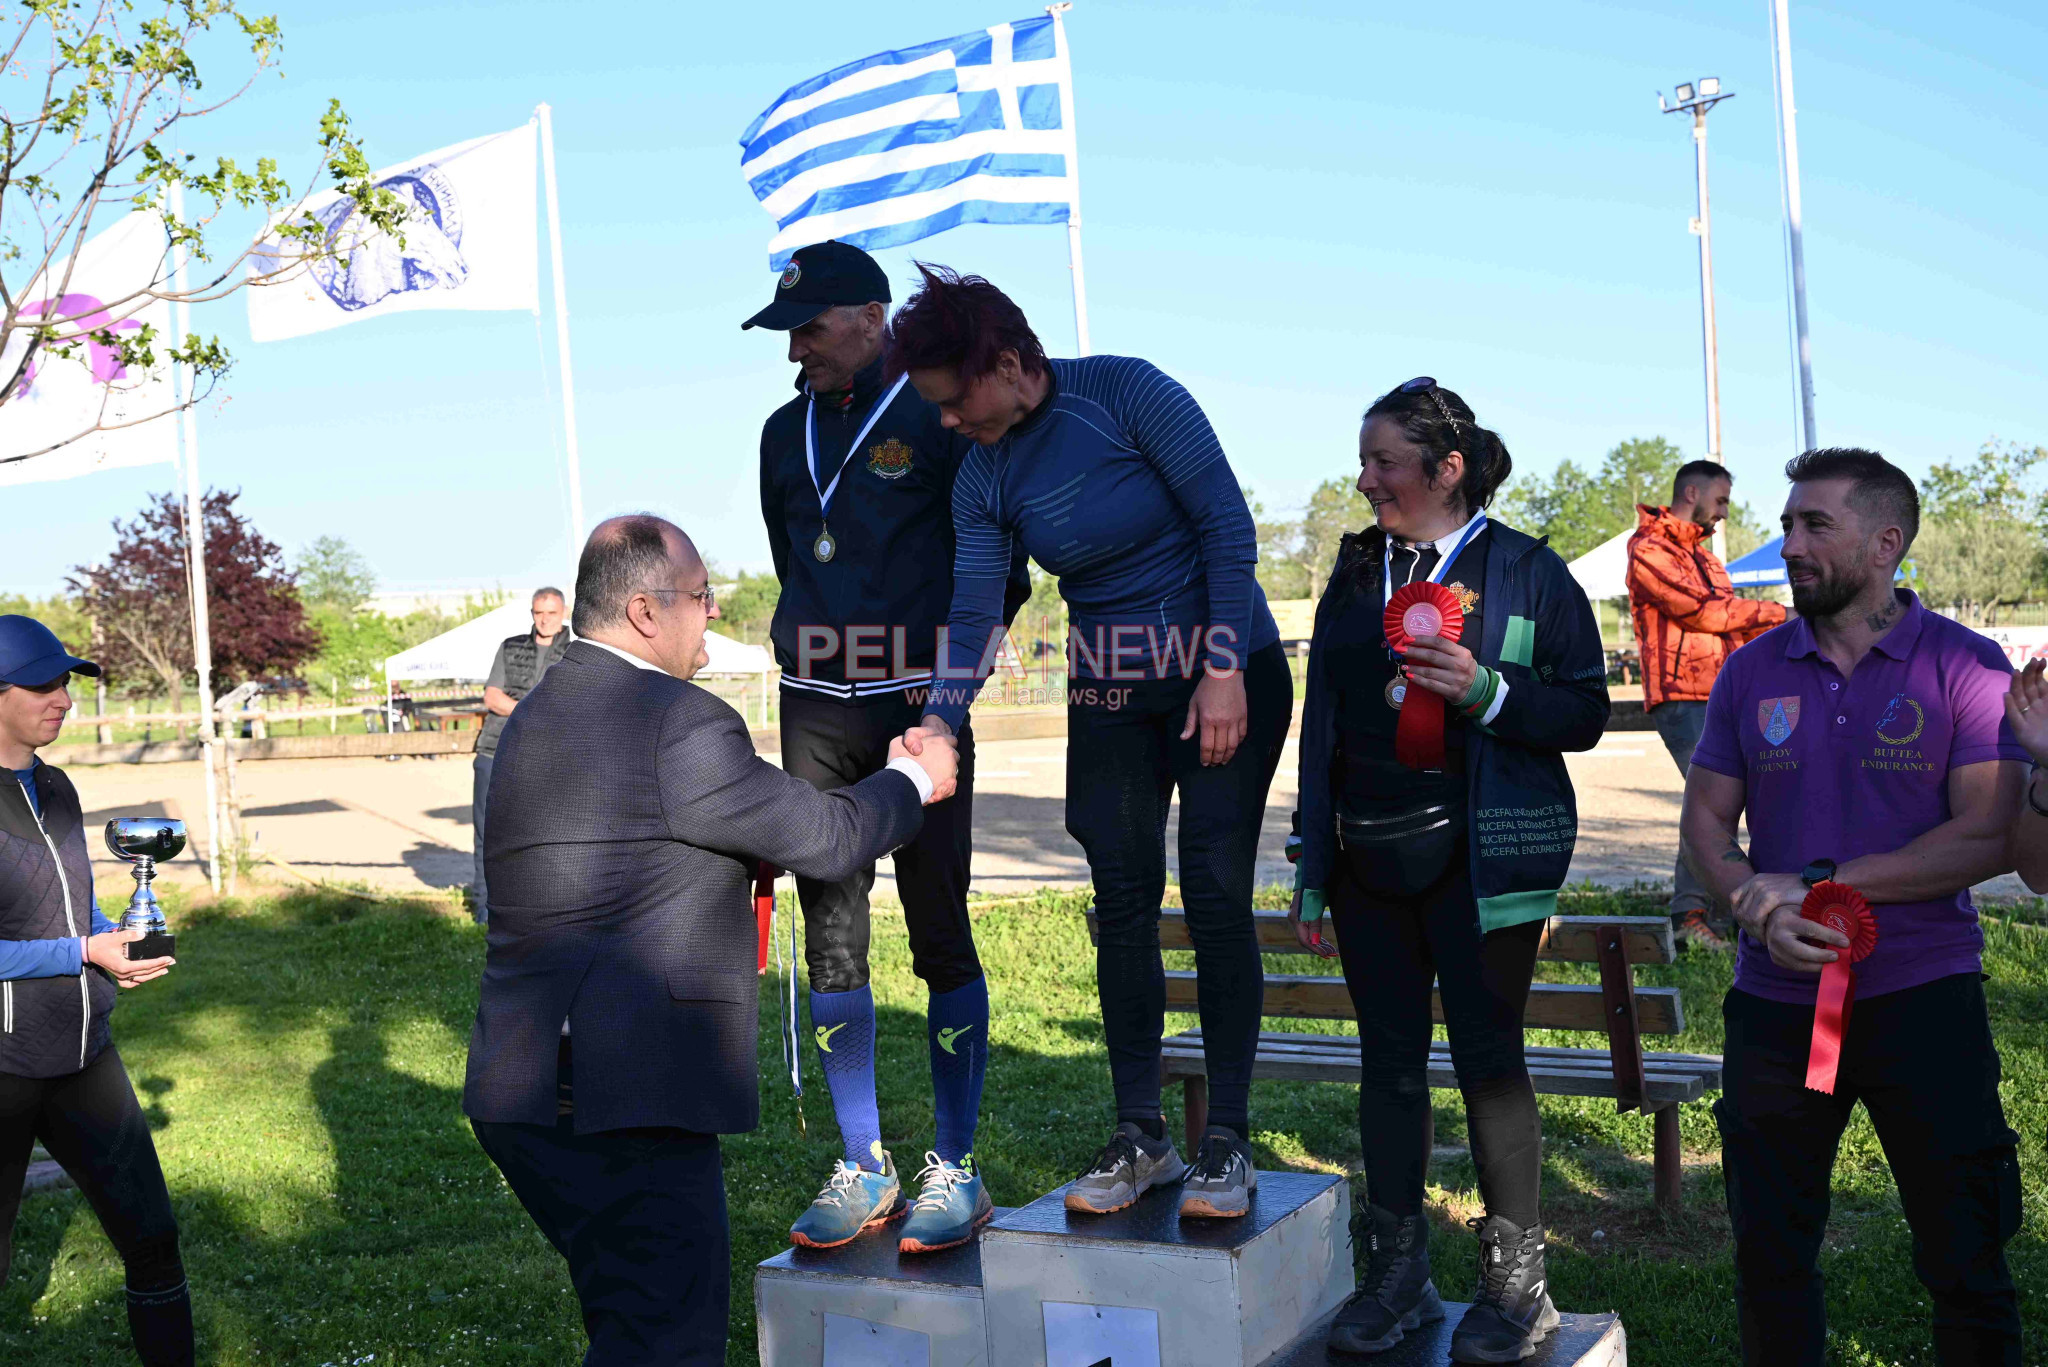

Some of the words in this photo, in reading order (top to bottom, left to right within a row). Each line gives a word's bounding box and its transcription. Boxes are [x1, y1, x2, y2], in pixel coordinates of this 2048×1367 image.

[1759, 748, 1793, 760] ILFOV
[1873, 747, 1923, 759] BUFTEA
[1756, 760, 1799, 772] COUNTY
[1861, 759, 1935, 771] ENDURANCE
[1476, 807, 1513, 818] BUCEFAL
[1477, 820, 1516, 831] BUCEFAL
[1479, 833, 1519, 845] BUCEFAL
[1481, 846, 1520, 858] BUCEFAL
